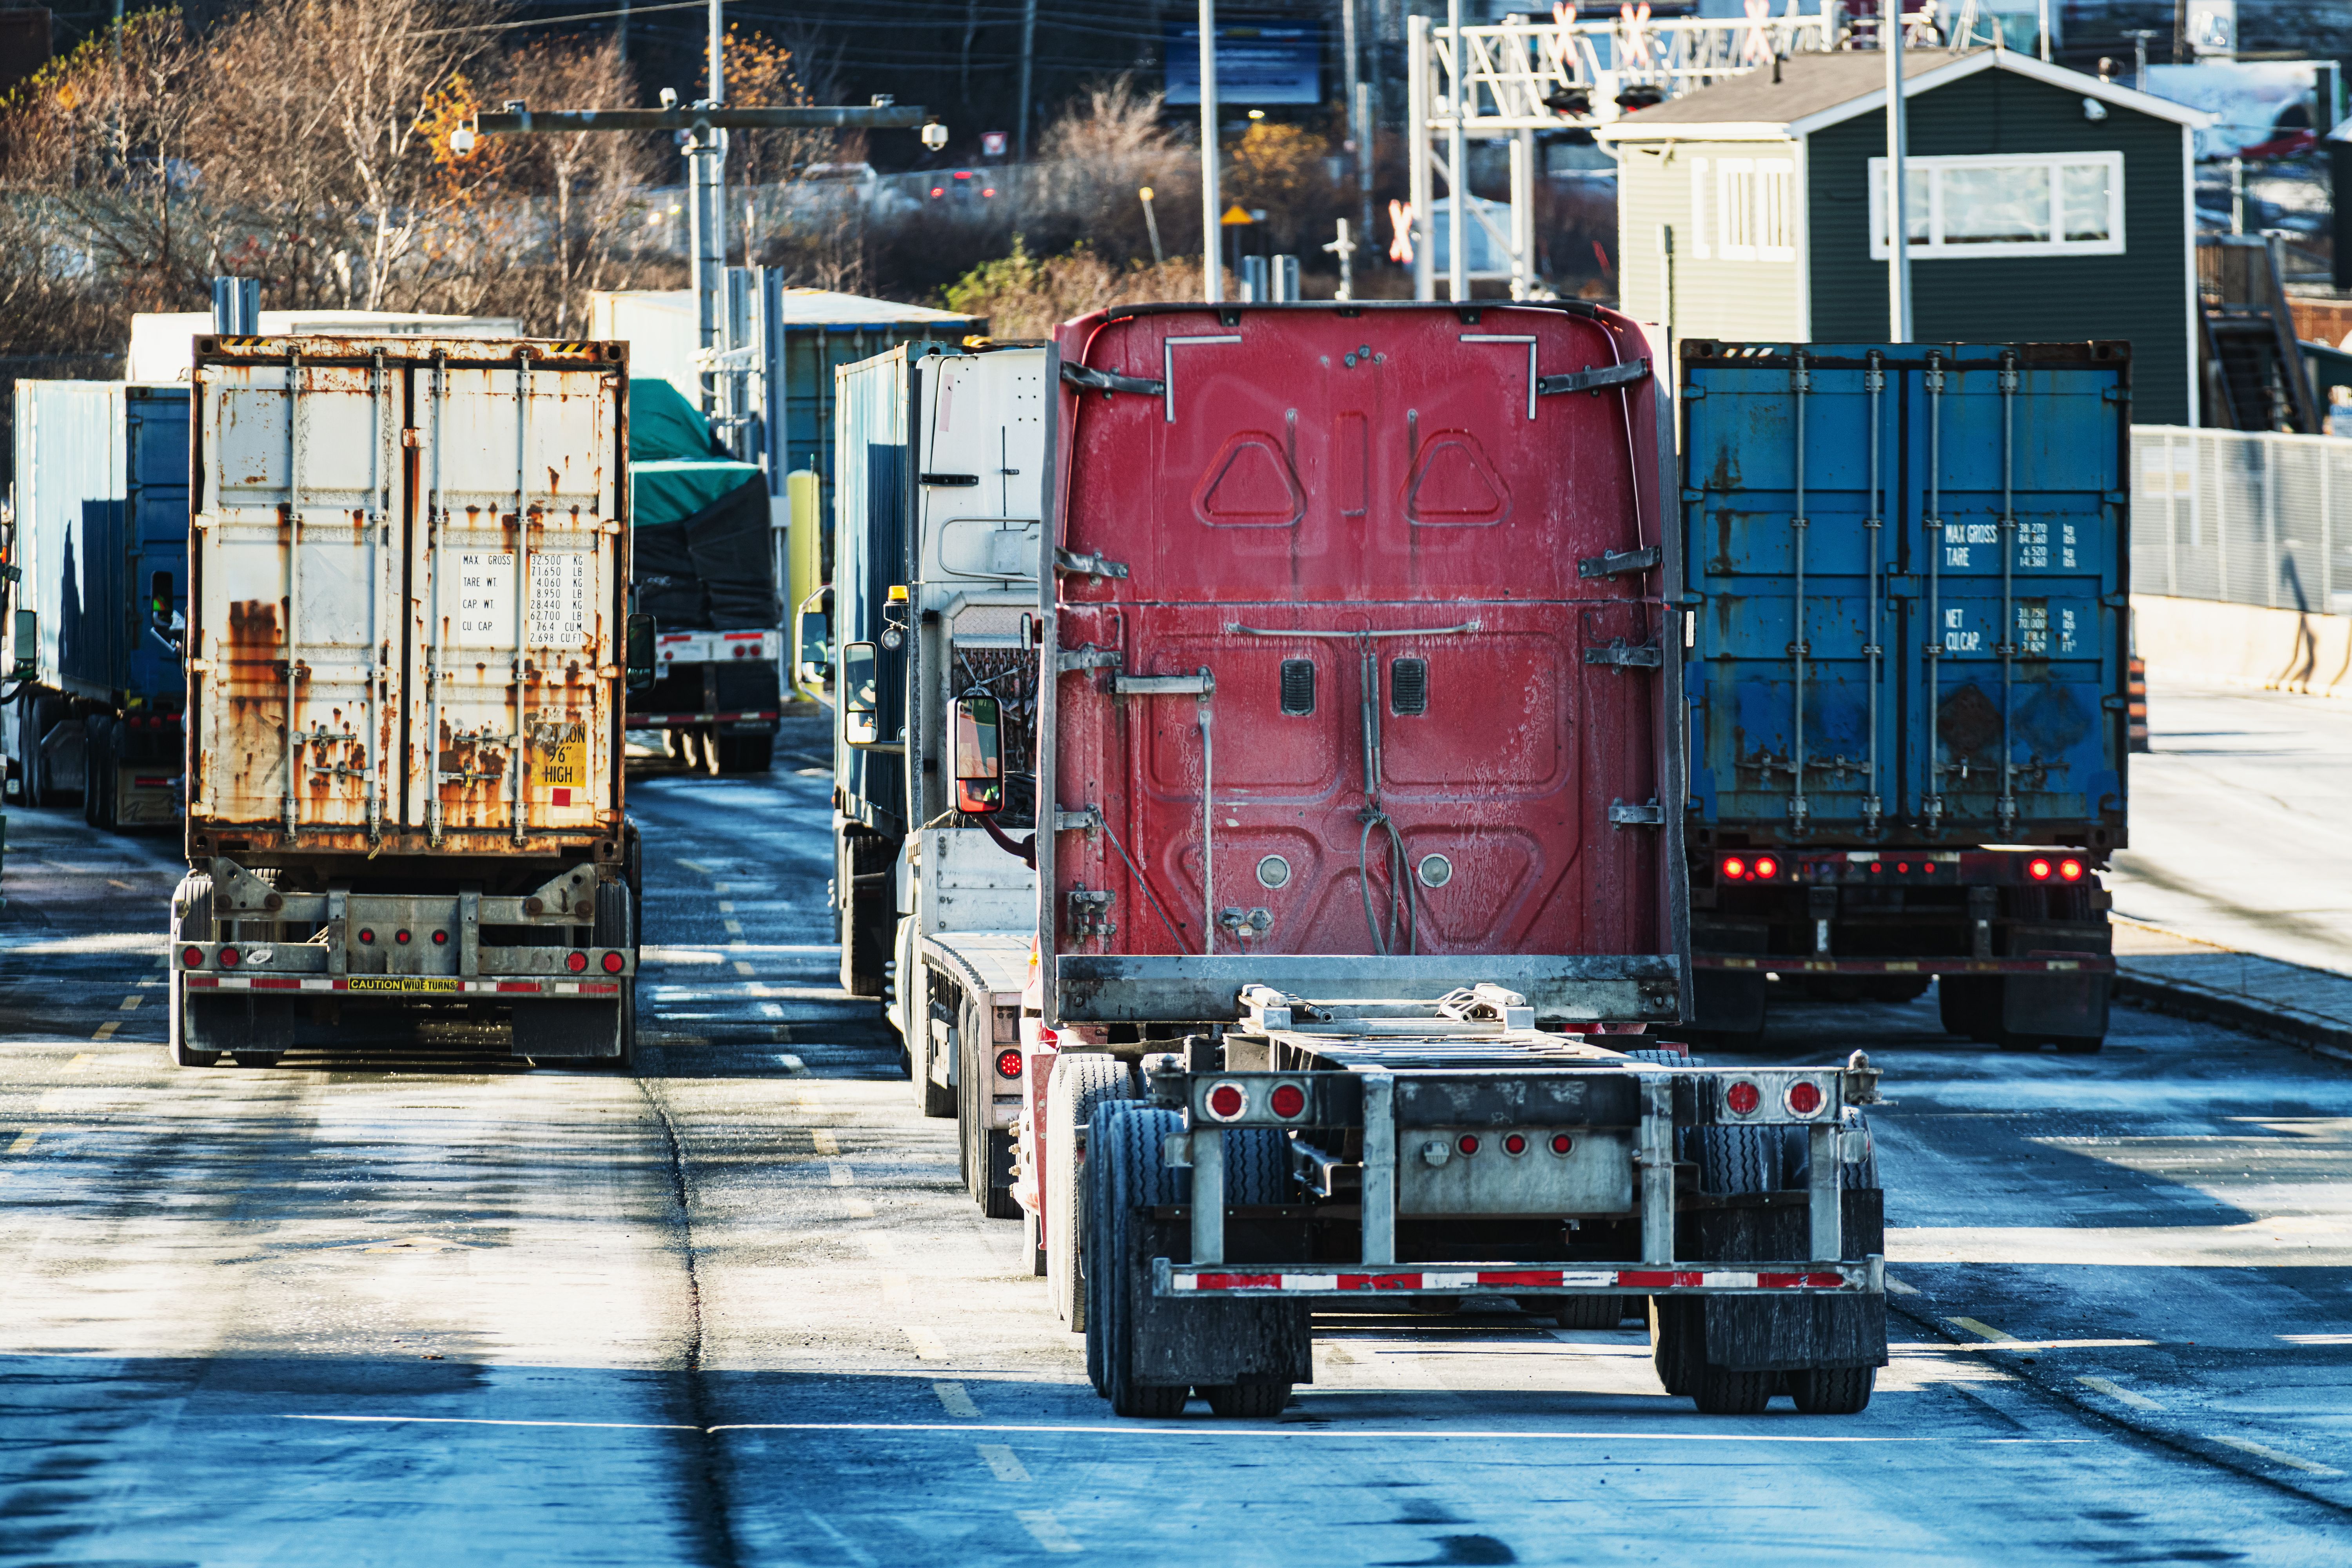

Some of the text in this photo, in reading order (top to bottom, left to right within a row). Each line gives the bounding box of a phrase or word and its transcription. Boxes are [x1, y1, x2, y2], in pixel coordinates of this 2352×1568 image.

[1945, 524, 1998, 543] MAX GROSS
[2063, 523, 2075, 535] kg
[2063, 534, 2076, 544] lbs
[1945, 547, 1970, 566] TARE
[2063, 546, 2075, 559] kg
[463, 555, 510, 565] MAX. GROSS
[573, 555, 583, 565] KG
[2063, 557, 2076, 567] lbs
[573, 567, 582, 576] LB
[464, 577, 498, 587] TARE WT.
[573, 578, 582, 587] KG
[573, 589, 582, 598] LB
[463, 599, 495, 608] CAP. WT.
[573, 600, 582, 609] KG
[573, 611, 581, 620] LB
[1945, 609, 1964, 628] NET
[2063, 608, 2074, 621] kg
[478, 621, 493, 630] CAP.
[537, 622, 582, 632] 76.4 CU.M
[2063, 618, 2076, 629] lbs
[561, 633, 581, 642] CU.FT
[545, 765, 572, 782] HIGH
[351, 980, 399, 989] CAUTION
[404, 980, 455, 990] WIDE TURNS
